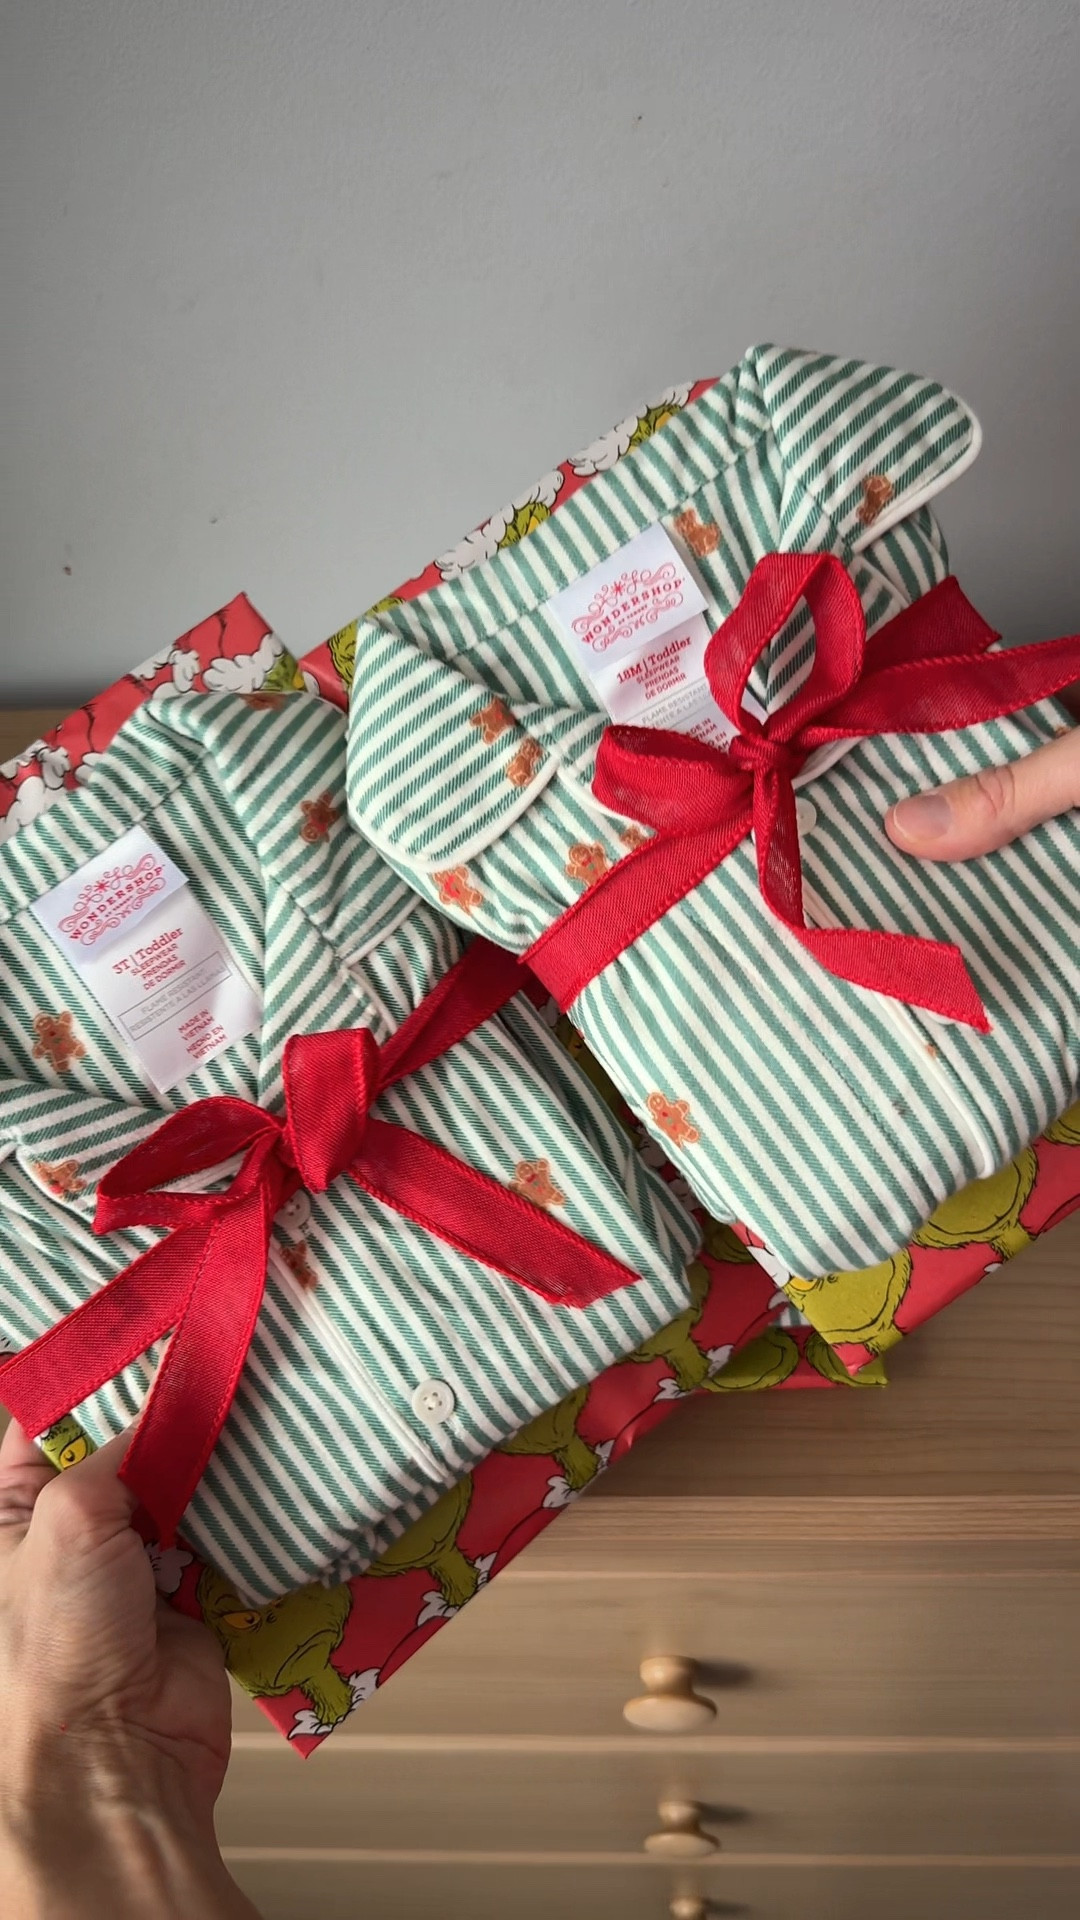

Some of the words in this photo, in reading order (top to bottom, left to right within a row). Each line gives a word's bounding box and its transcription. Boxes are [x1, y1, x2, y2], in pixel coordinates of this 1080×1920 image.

[582, 578, 683, 644] WONDERSHOP
[617, 662, 643, 684] 18M
[647, 636, 692, 667] Toddler
[636, 655, 680, 684] SLEEPWEAR
[644, 666, 679, 690] PRENDAS
[645, 688, 656, 700] DE
[656, 673, 687, 696] DORMIR
[69, 866, 163, 940] WONDERSHOP
[135, 927, 184, 959] Toddler
[130, 943, 179, 976] SLEEPWEAR
[141, 954, 179, 979] PRENDAS
[143, 978, 155, 991] DE
[155, 960, 187, 985] DORMIR
[178, 1014, 200, 1033] MADE
[199, 1009, 210, 1021] IN
[182, 1016, 215, 1041] VIETNAM
[186, 1031, 212, 1054] HECHO
[211, 1024, 224, 1036] EN
[192, 1034, 227, 1060] VIETNAM
